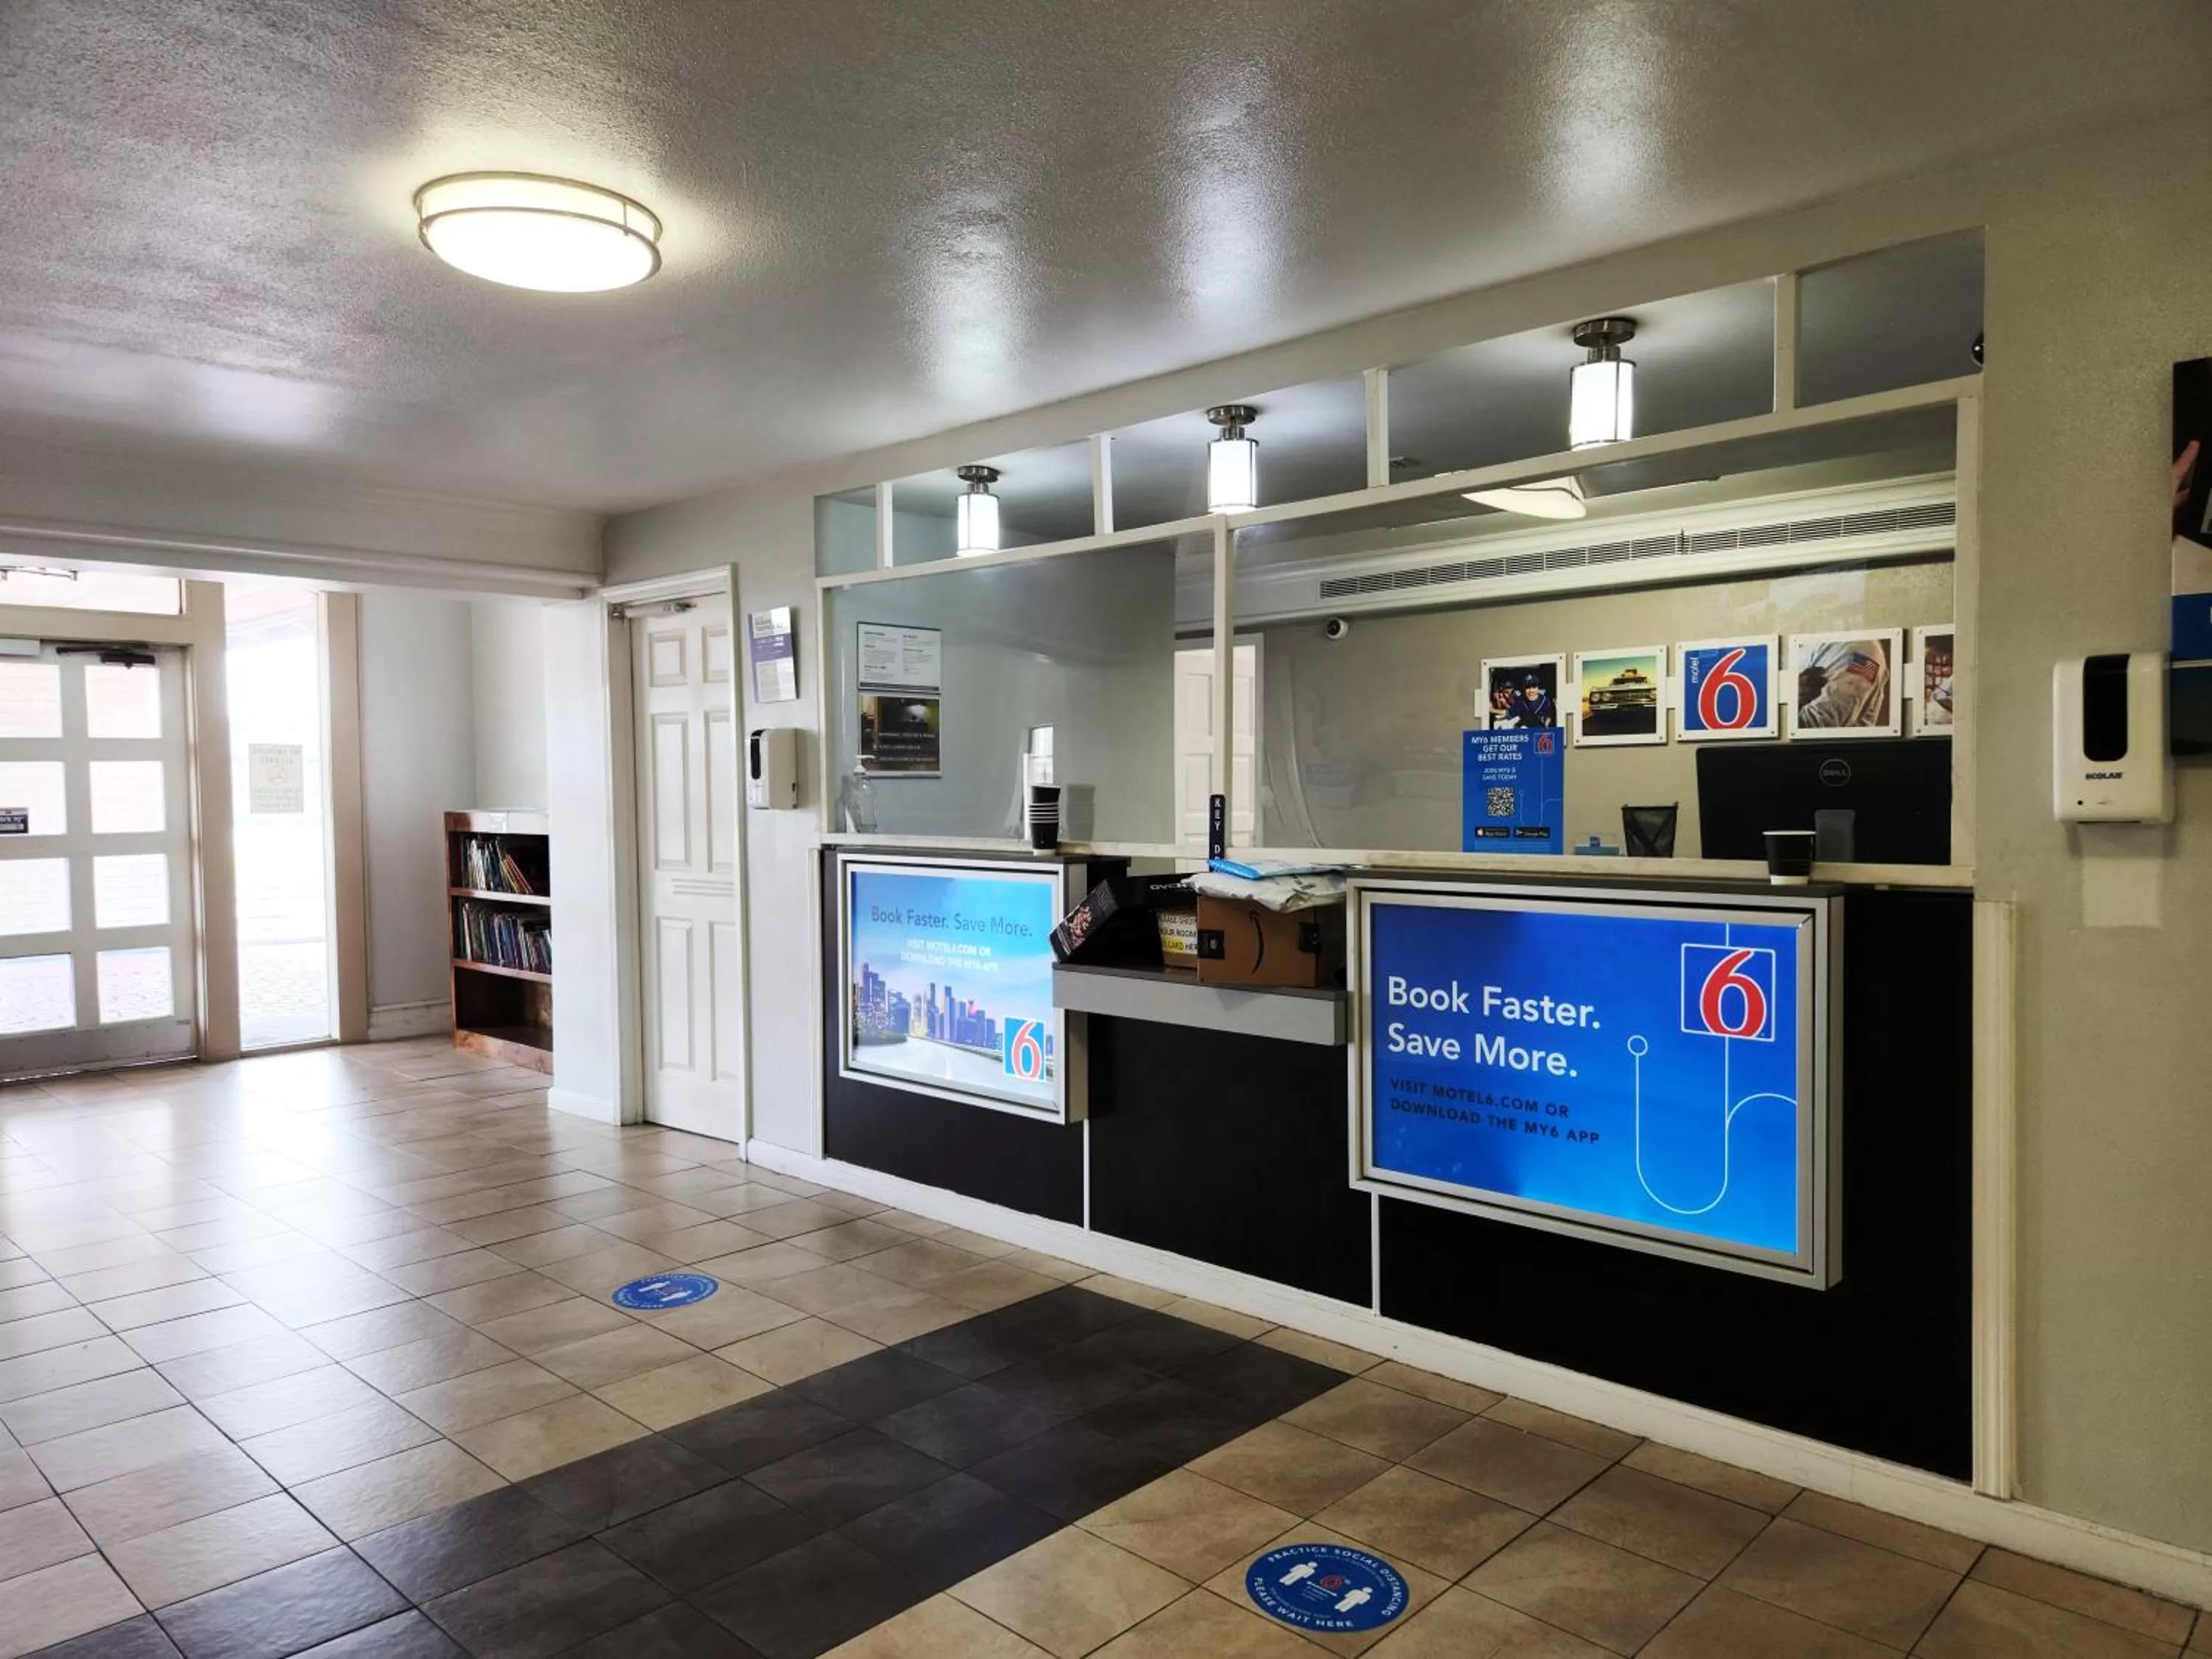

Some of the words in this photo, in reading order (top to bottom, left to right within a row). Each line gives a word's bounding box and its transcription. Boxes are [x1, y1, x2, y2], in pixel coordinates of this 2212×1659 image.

[1689, 657, 1699, 684] motel
[1698, 649, 1757, 730] 6
[1478, 753, 1496, 761] BEST
[1498, 752, 1522, 760] RATES
[1483, 744, 1498, 752] GET
[1490, 734, 1528, 743] MEMBERS
[872, 905, 902, 923] Book
[907, 909, 949, 929] Faster.
[954, 914, 985, 932] Save
[990, 917, 1032, 937] More.
[1388, 975, 1470, 1014] Book
[1483, 986, 1600, 1029] Faster.
[1700, 948, 1767, 1038] 6
[1011, 1020, 1042, 1080] 6
[1388, 1023, 1461, 1060] Save
[1475, 1033, 1577, 1077] More.
[1390, 1099, 1481, 1124] DOWNLOAD
[1487, 1115, 1517, 1130] THE
[1525, 1121, 1558, 1138] MY6
[1566, 1129, 1600, 1144] APP
[1391, 1079, 1425, 1094] VISIT
[1433, 1085, 1538, 1113] MOTEL6.COM
[1545, 1103, 1569, 1118] OR
[1253, 1577, 1277, 1607] PLEASE
[1277, 1607, 1310, 1623] WAIT
[1267, 1546, 1327, 1562] PRACTICE
[1334, 1548, 1379, 1568] SOCIAL
[1380, 1568, 1404, 1616] DISTANCING
